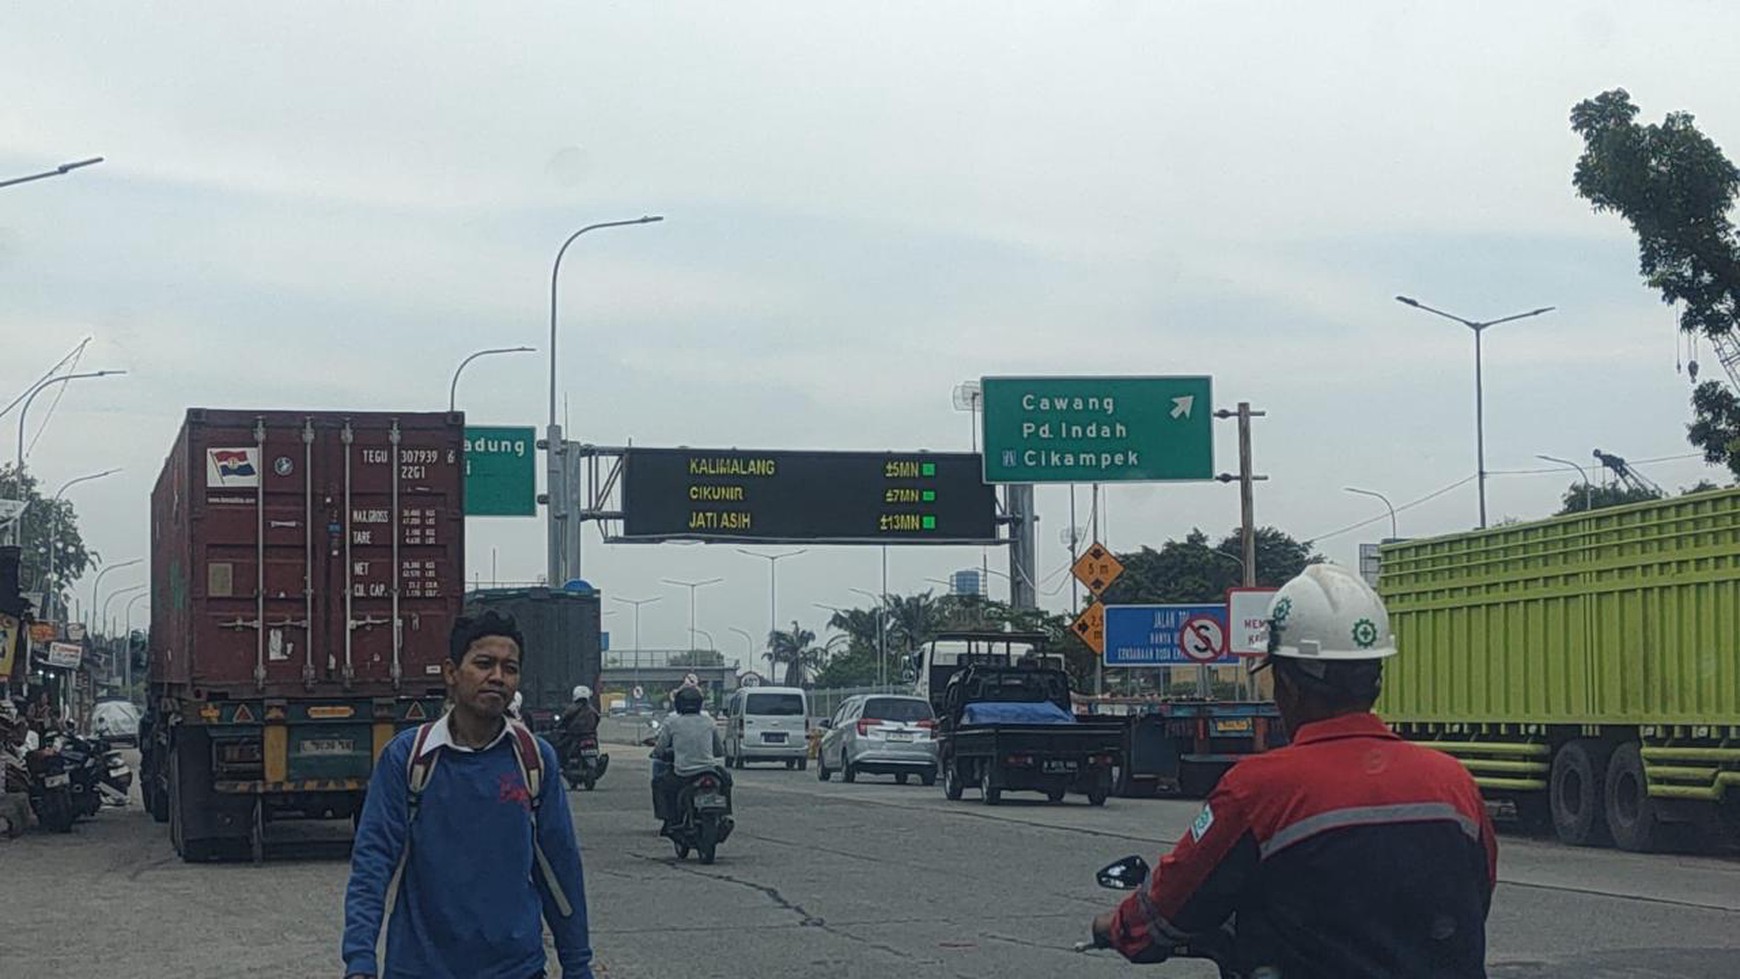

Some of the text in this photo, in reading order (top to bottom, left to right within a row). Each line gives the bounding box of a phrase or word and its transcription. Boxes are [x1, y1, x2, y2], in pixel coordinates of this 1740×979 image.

[1022, 394, 1114, 414] Cawang
[1061, 423, 1126, 438] Indah
[362, 450, 388, 463] TEGU
[401, 450, 438, 463] 307939
[1024, 450, 1139, 468] Cikampek
[401, 466, 425, 479] 22G1
[690, 458, 776, 475] KALIMALANG
[689, 486, 743, 500] CIKUNIR
[688, 511, 717, 529] JATI
[720, 512, 751, 529] ASIH
[353, 531, 371, 544] TARE
[354, 562, 369, 576] NET
